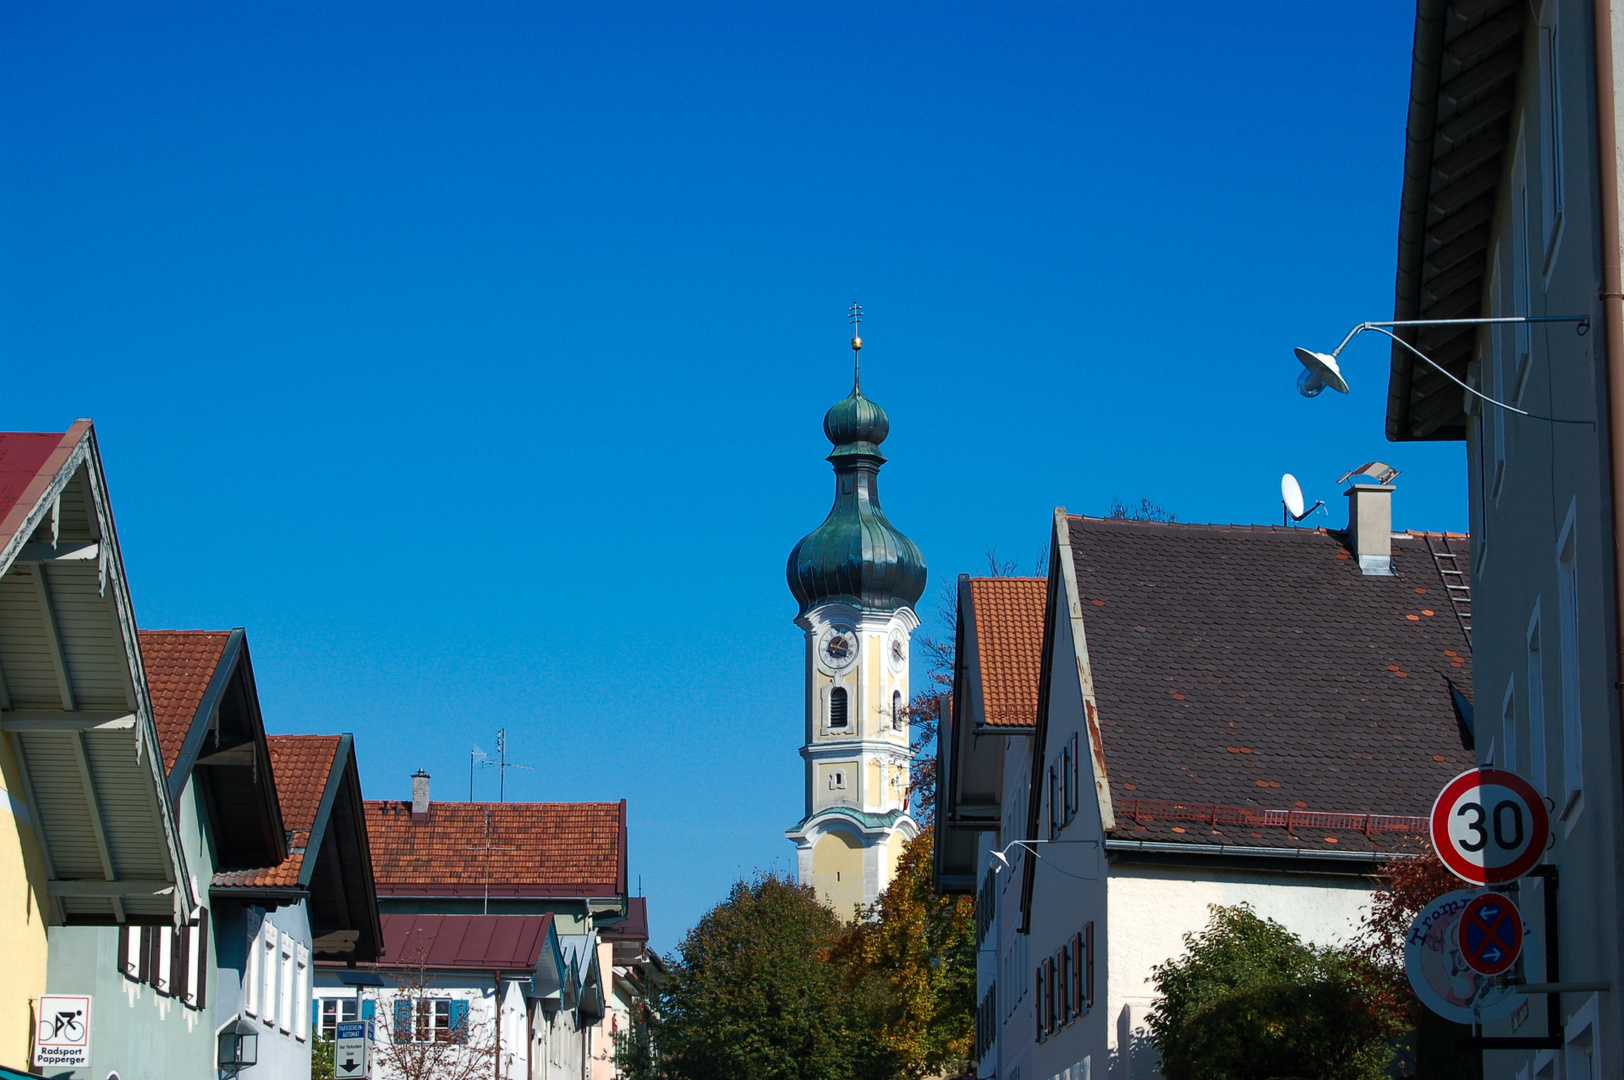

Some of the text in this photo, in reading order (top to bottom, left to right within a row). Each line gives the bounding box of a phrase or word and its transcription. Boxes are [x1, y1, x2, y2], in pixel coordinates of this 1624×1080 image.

[1457, 800, 1523, 852] 30
[41, 1047, 82, 1056] Radsport
[37, 1055, 85, 1065] Papperger
